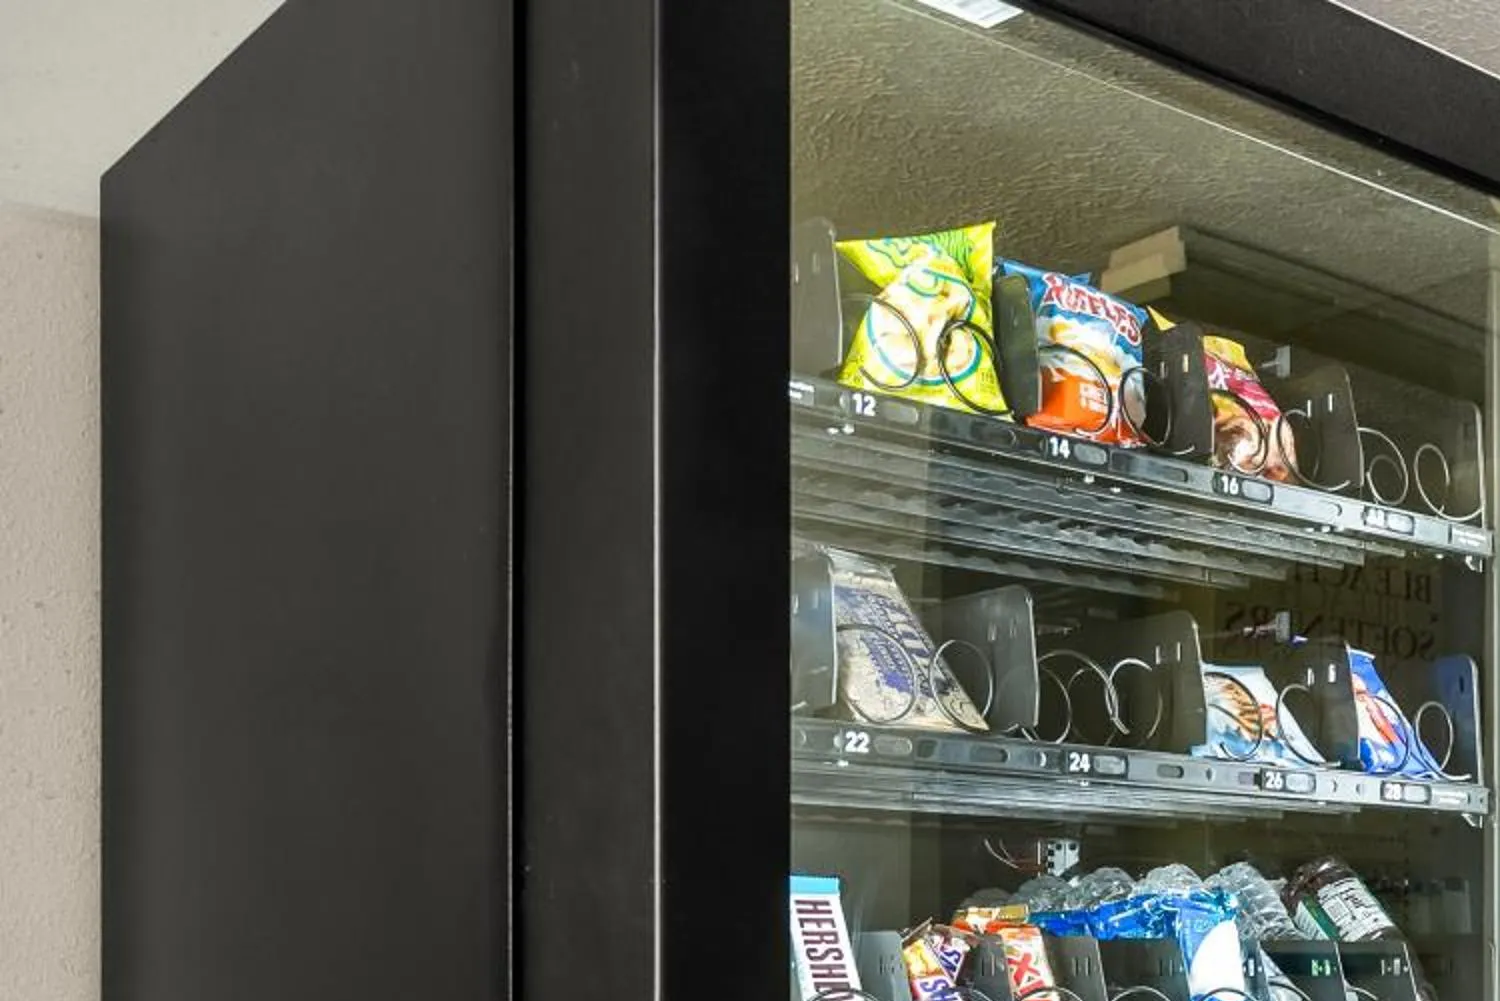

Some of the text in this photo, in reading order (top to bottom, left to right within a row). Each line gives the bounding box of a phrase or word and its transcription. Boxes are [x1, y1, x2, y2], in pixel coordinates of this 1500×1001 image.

[1042, 272, 1142, 345] RUFFLES
[852, 394, 876, 417] 12
[1049, 437, 1070, 458] 14
[1220, 475, 1239, 495] 16
[844, 732, 871, 754] 22
[1069, 753, 1091, 772] 24
[1264, 774, 1284, 790] 26
[1385, 784, 1402, 800] 28
